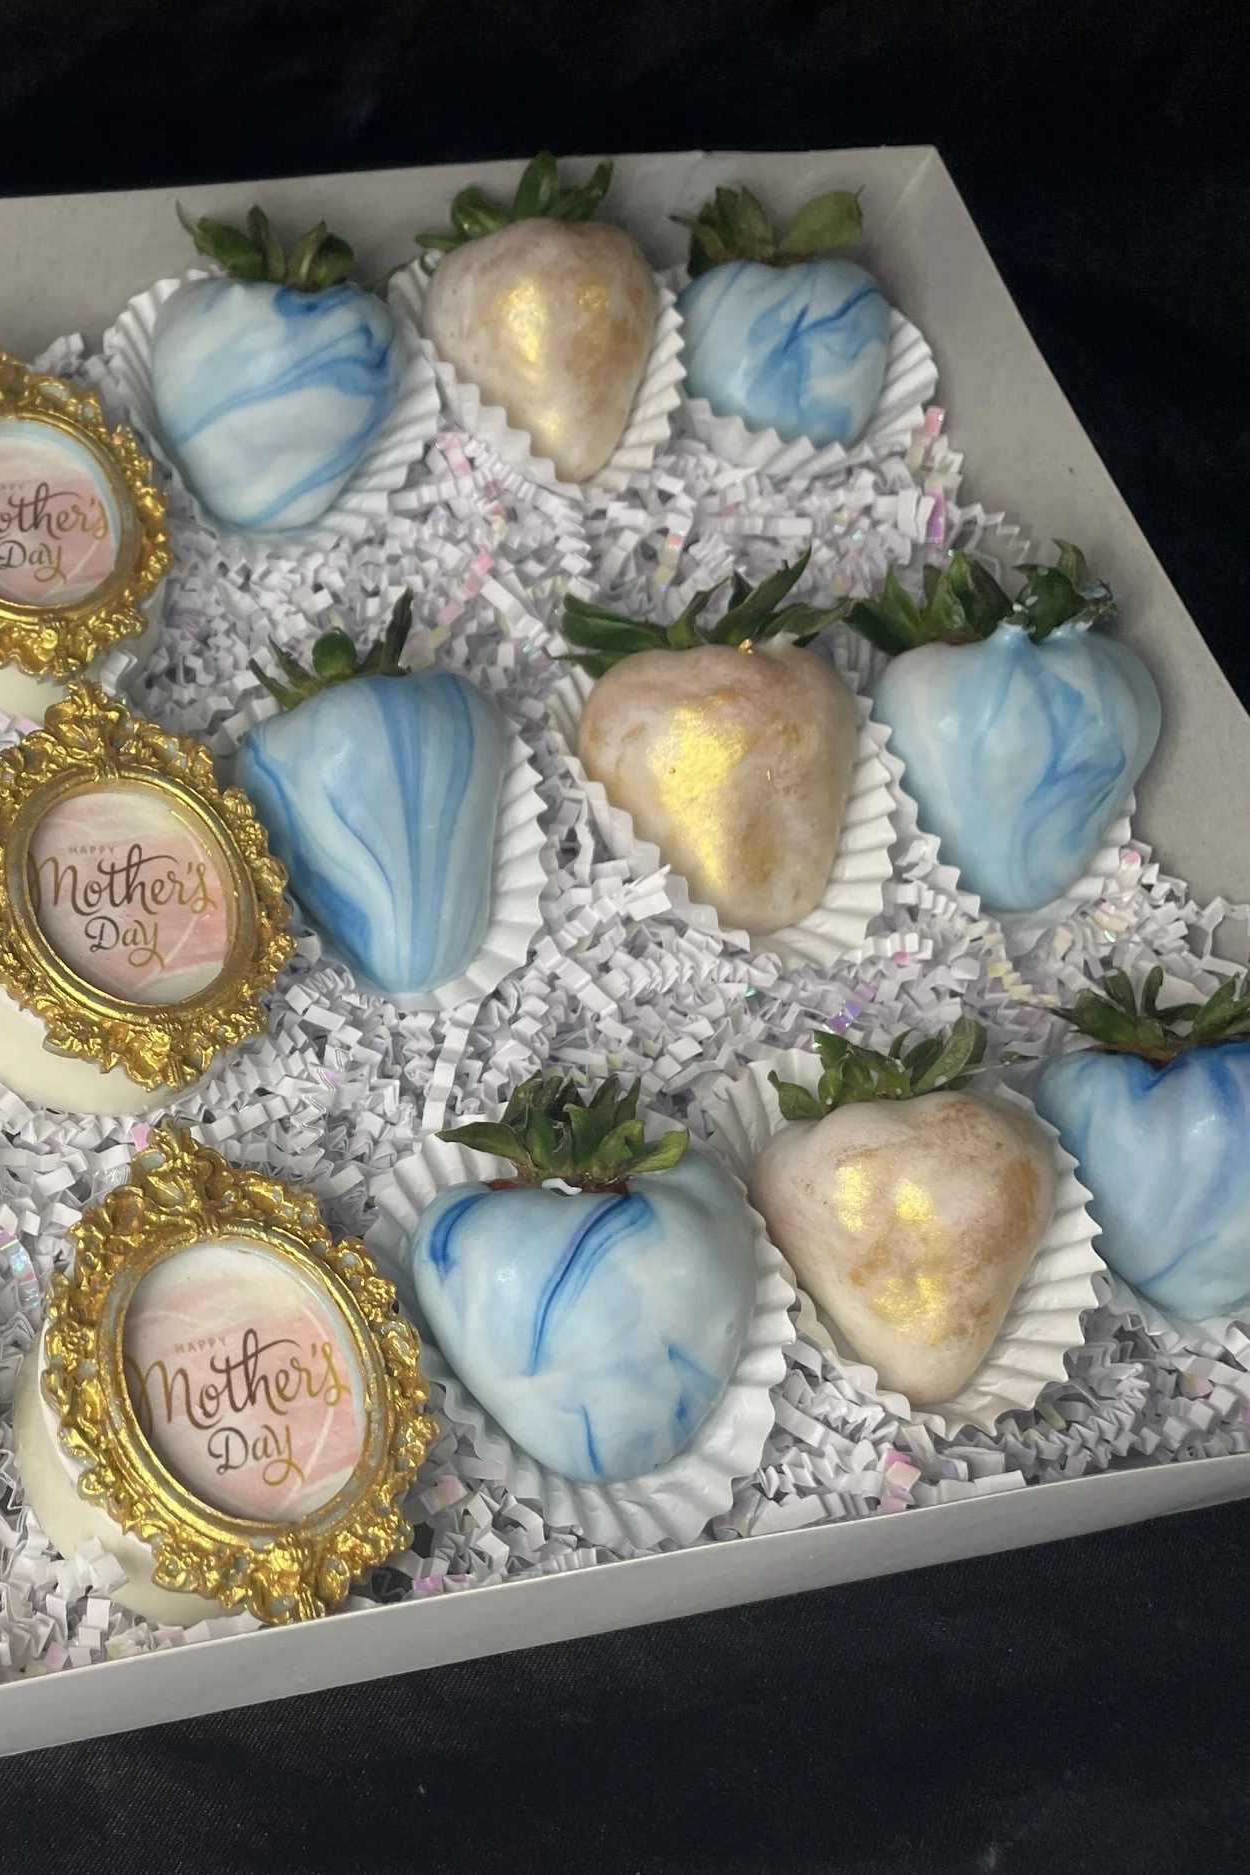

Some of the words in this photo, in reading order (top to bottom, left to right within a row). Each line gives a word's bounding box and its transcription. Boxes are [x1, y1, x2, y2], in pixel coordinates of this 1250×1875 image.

[68, 845, 115, 855] HAPPY
[36, 843, 219, 917] Mother's
[84, 915, 166, 971] Day
[174, 1336, 227, 1354] HAPPY
[124, 1328, 353, 1430] Mother's
[207, 1424, 306, 1487] Day
